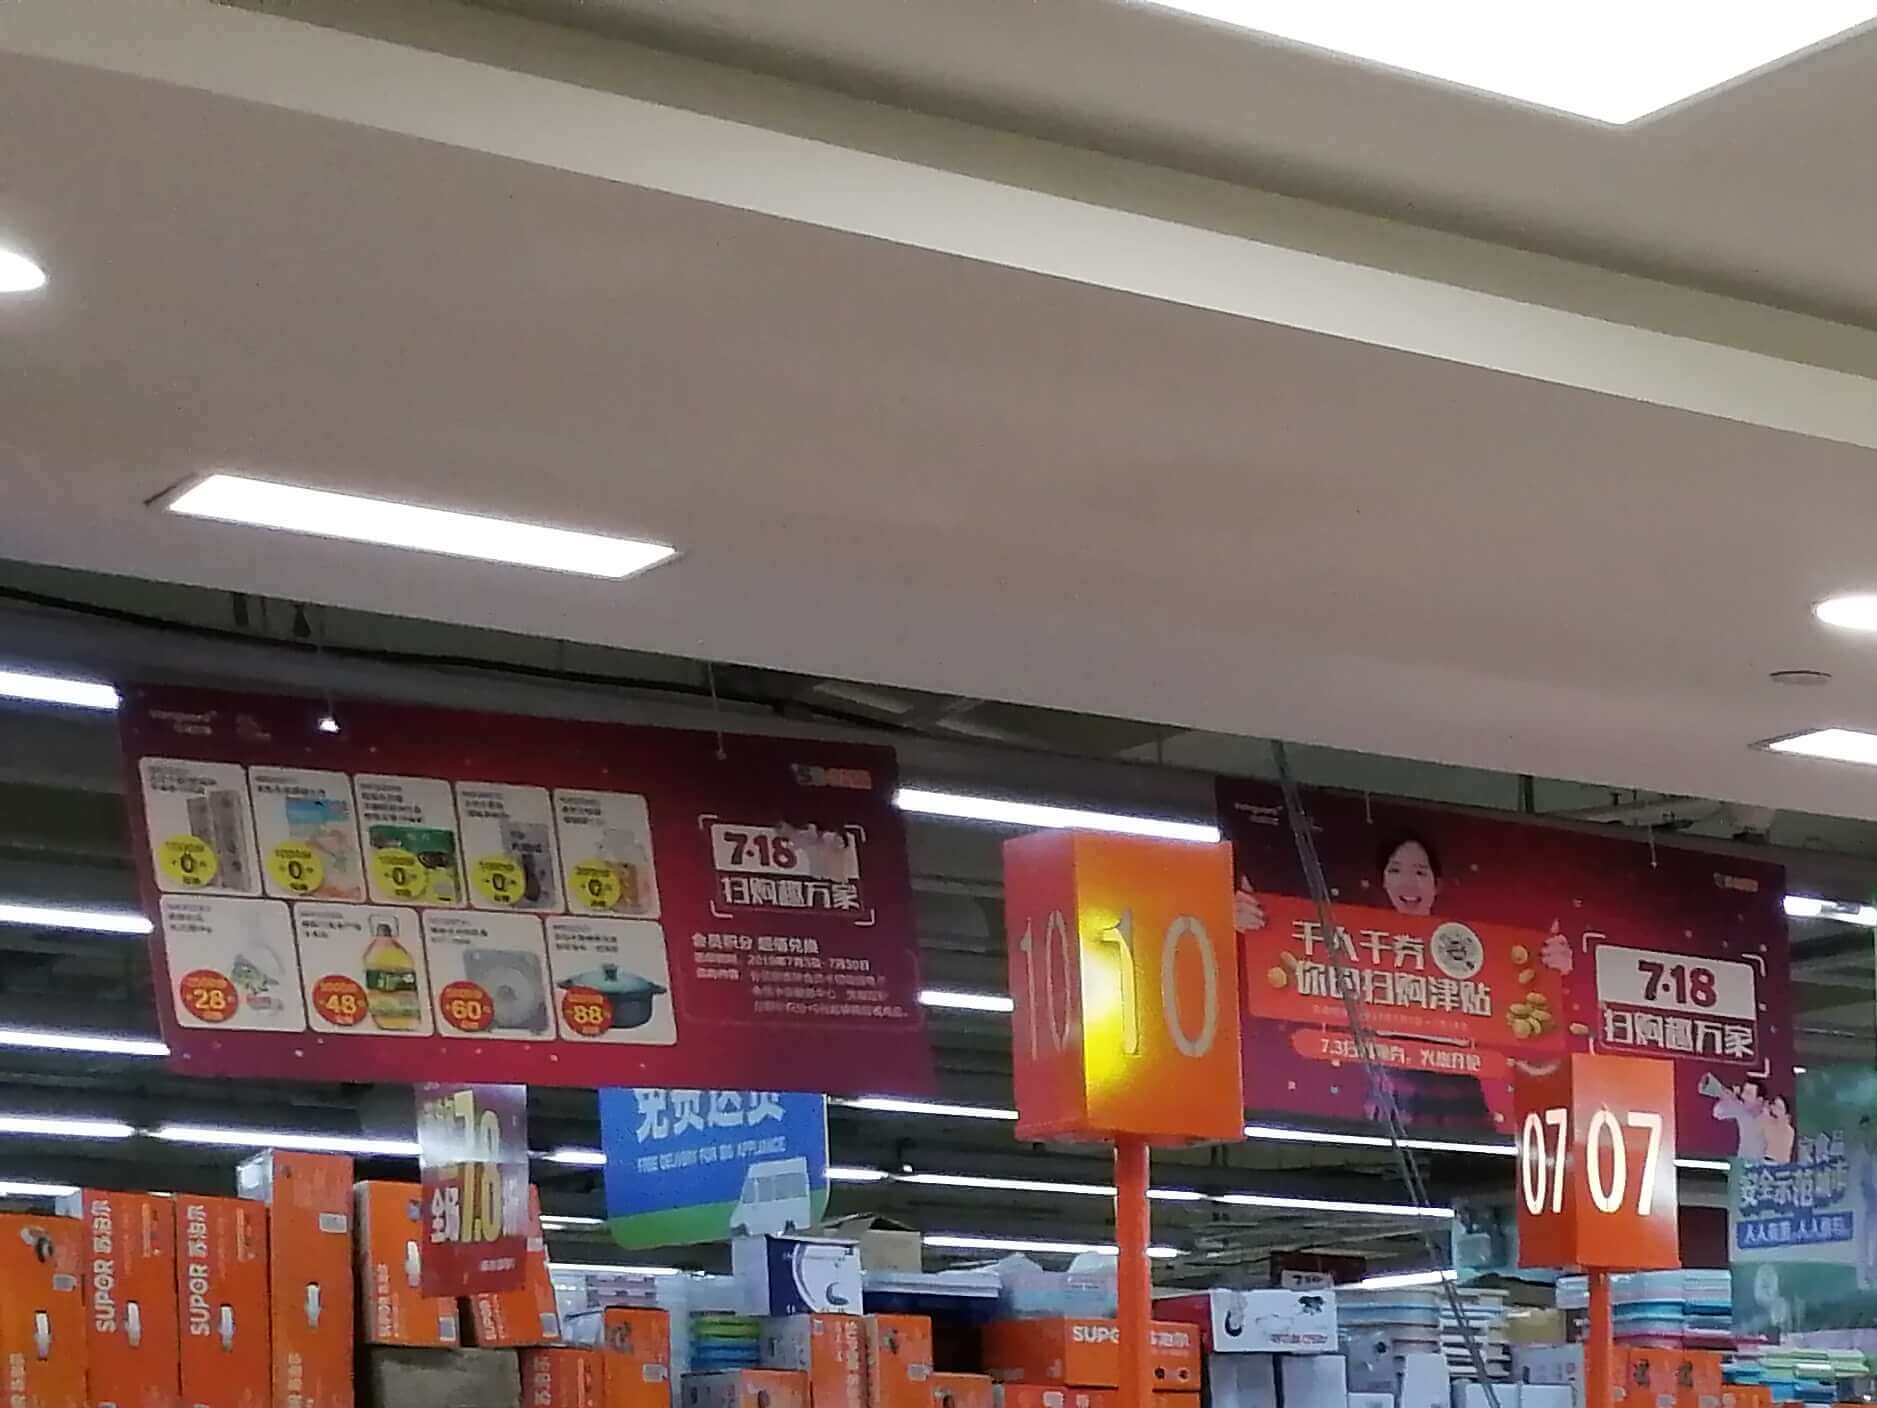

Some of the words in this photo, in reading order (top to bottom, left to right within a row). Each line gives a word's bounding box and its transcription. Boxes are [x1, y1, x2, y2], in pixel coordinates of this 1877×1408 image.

[193, 987, 226, 1010] 28
[452, 999, 481, 1021] 60
[1020, 909, 1072, 1059] 10
[1106, 907, 1220, 1058] 10
[1521, 1106, 1569, 1216] 07
[1583, 1108, 1664, 1217] 07
[93, 1259, 115, 1333] SUPOR
[187, 1264, 210, 1337] SUPOR
[1073, 1326, 1120, 1343] SUP
